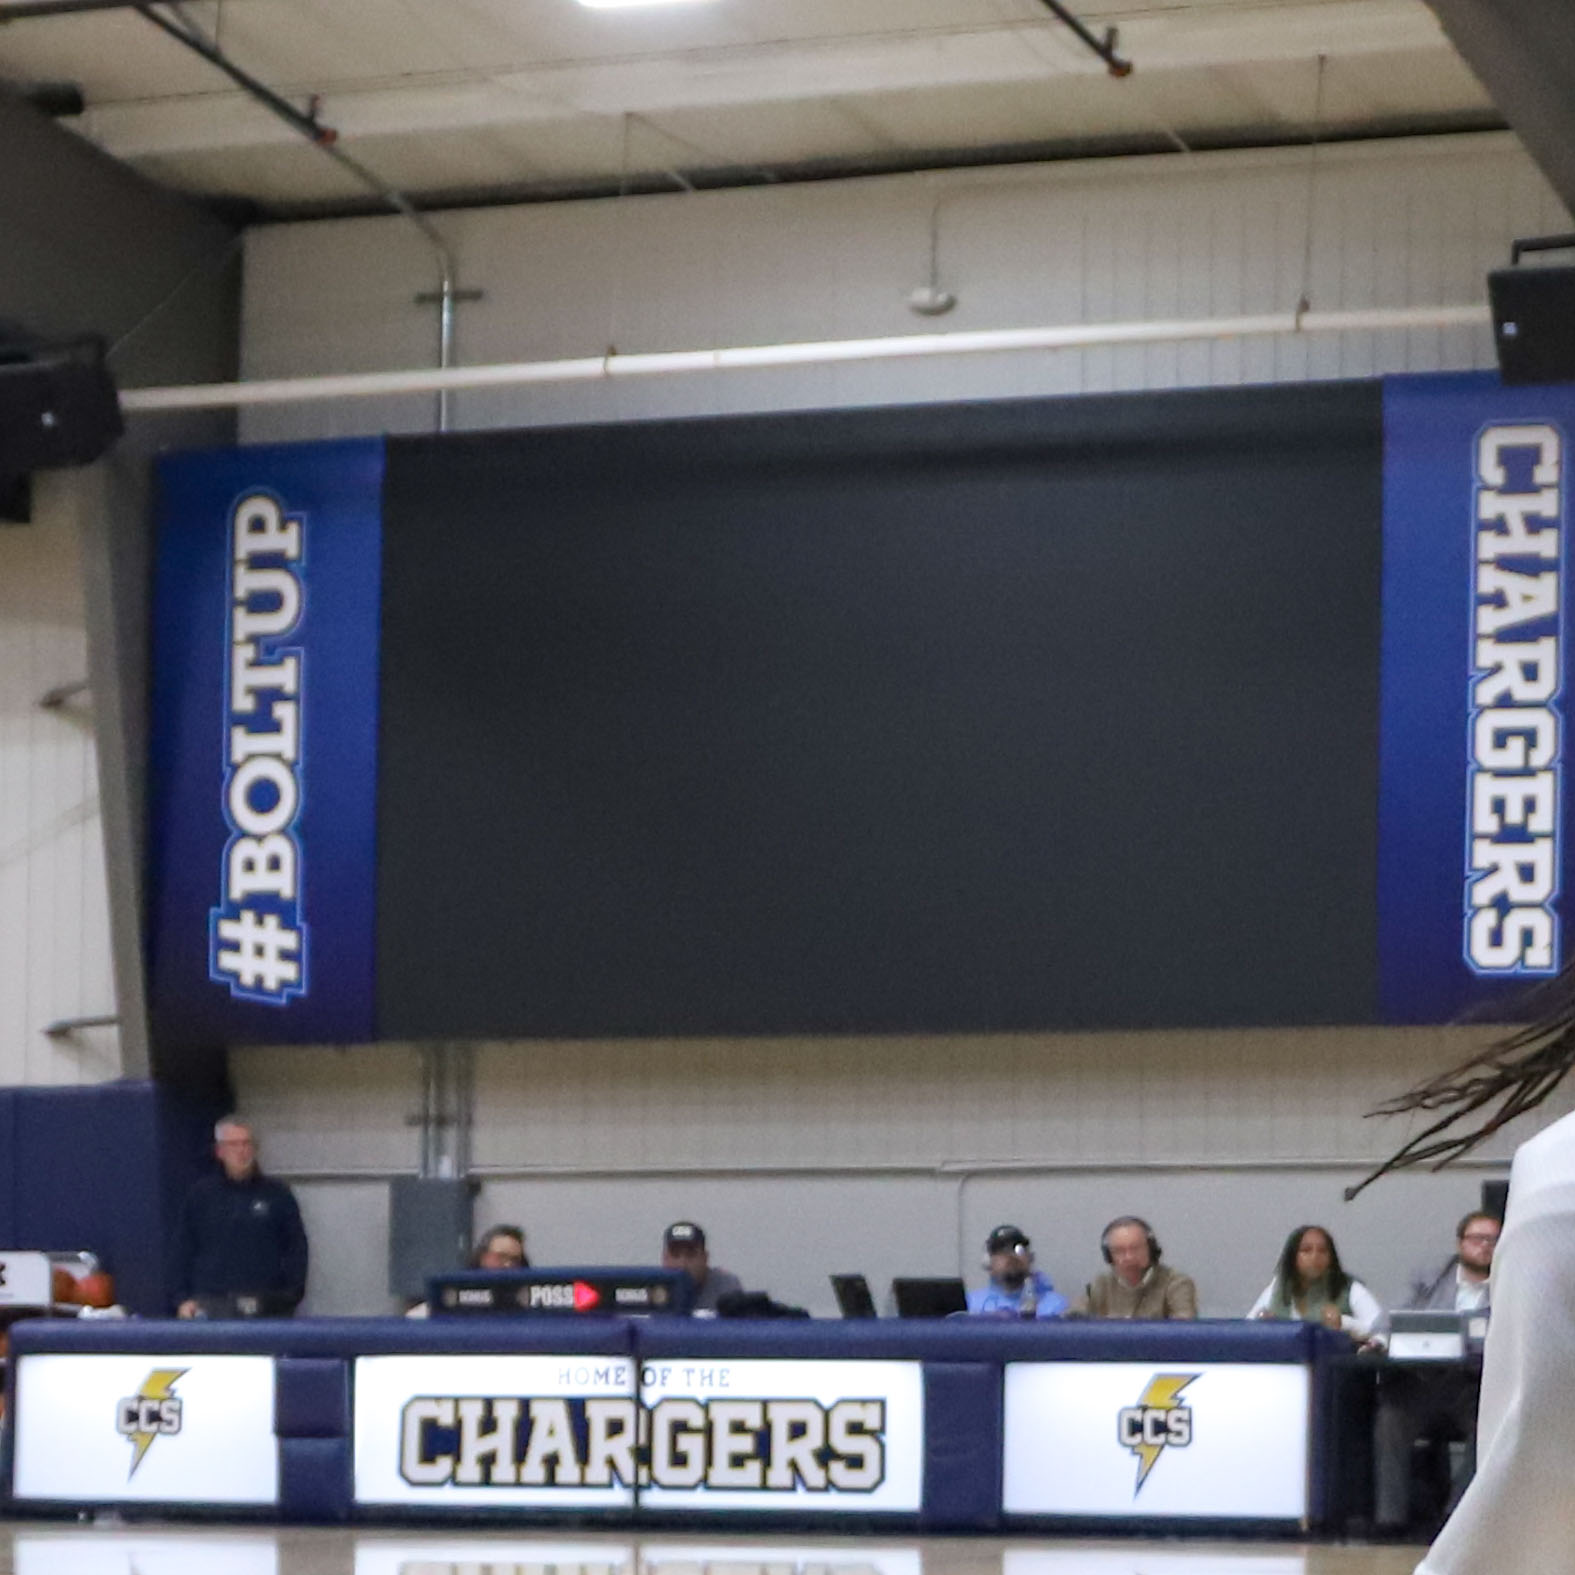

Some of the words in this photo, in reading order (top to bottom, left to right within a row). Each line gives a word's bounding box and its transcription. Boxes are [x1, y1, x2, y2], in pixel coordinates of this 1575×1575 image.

[1468, 423, 1563, 971] CHARGERS
[218, 493, 303, 993] #BOLTUP
[530, 1286, 575, 1307] POSS
[558, 1366, 626, 1387] HOME
[641, 1367, 673, 1388] OF
[682, 1367, 731, 1388] THE
[116, 1396, 182, 1436] CCS
[1118, 1405, 1192, 1448] CCS
[399, 1396, 886, 1493] CHARGERS
